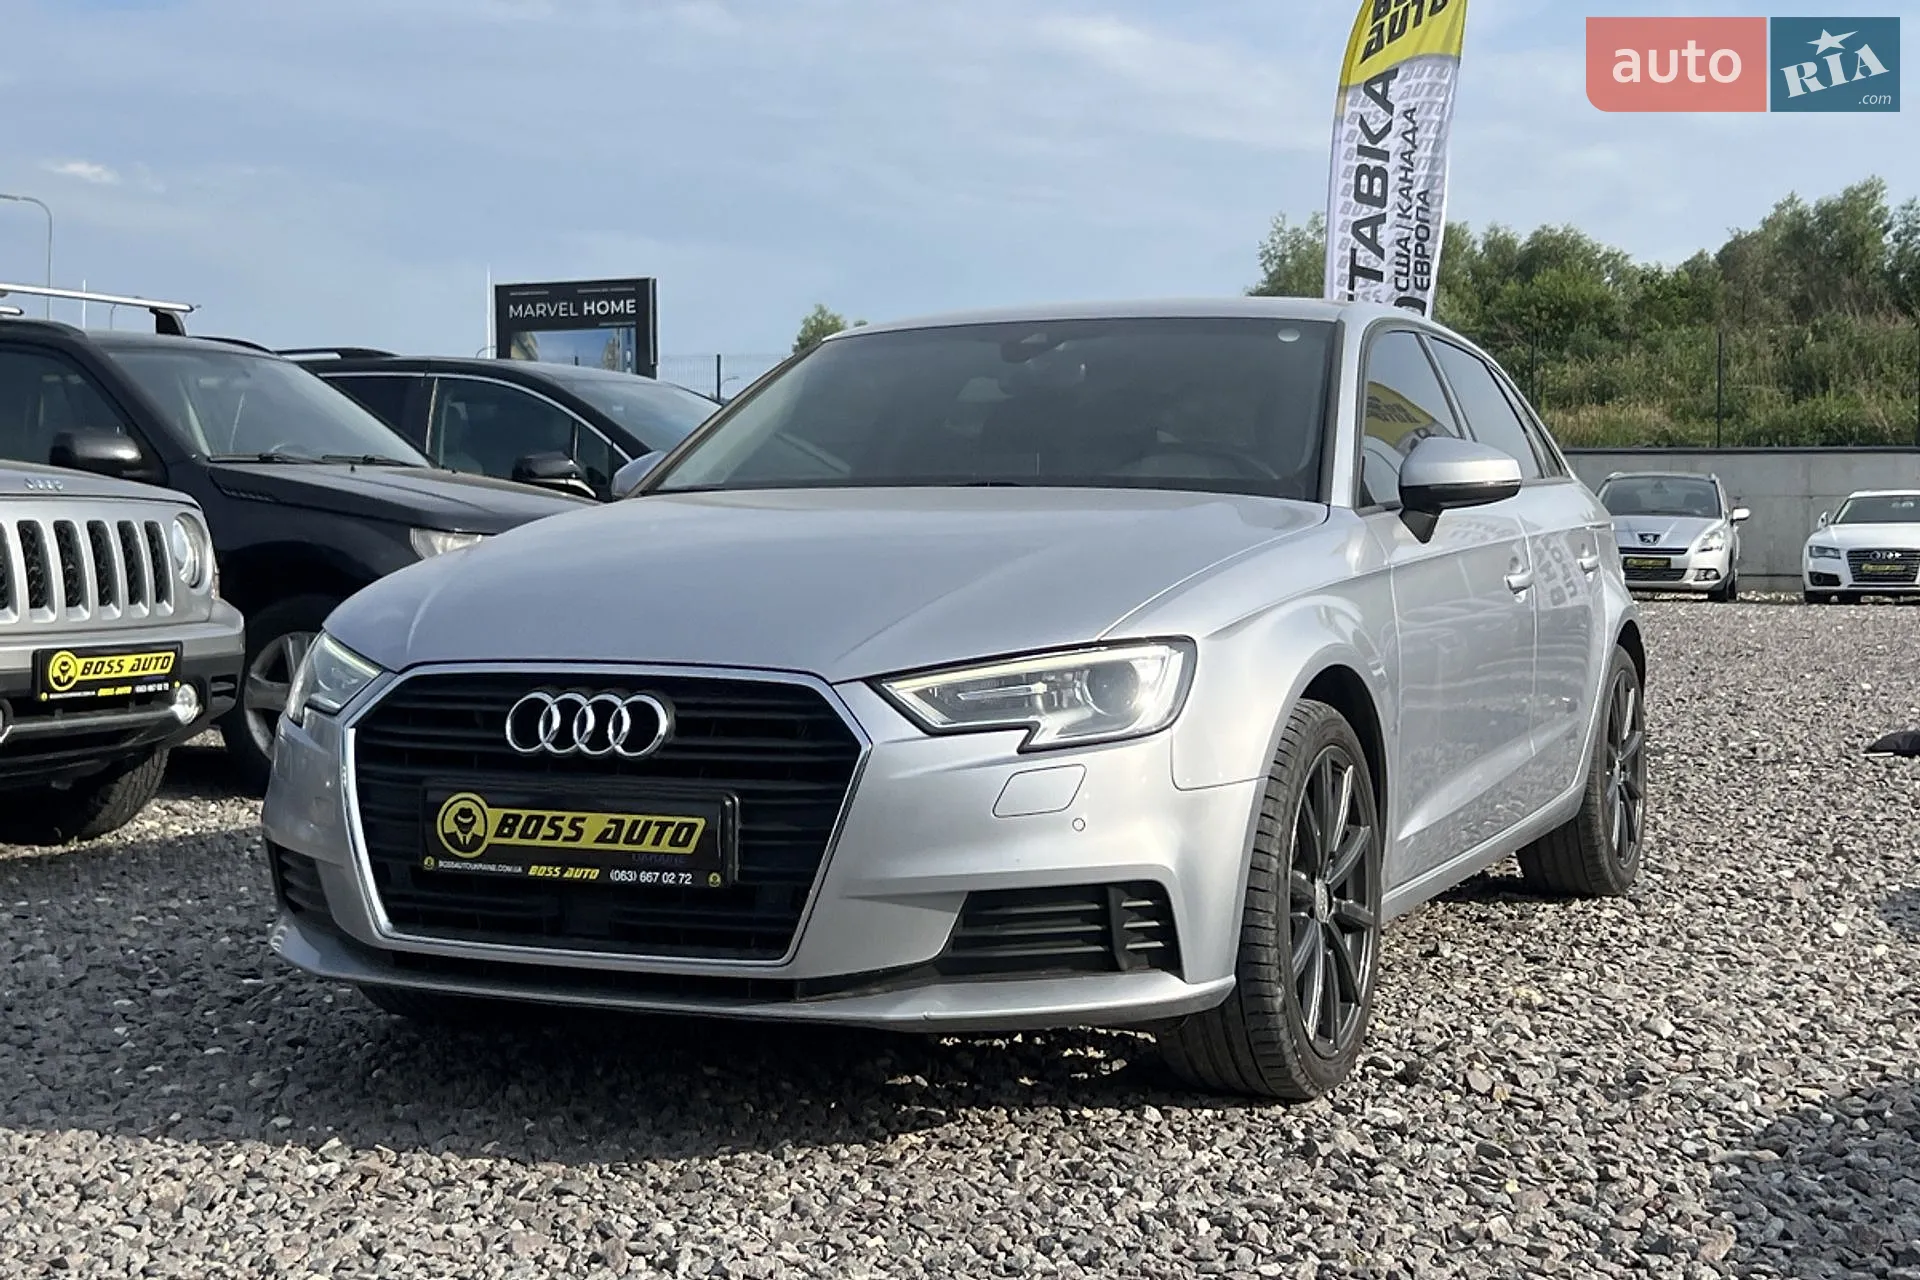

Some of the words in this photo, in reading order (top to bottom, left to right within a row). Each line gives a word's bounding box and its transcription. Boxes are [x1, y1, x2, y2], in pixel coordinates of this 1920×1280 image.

[1397, 107, 1419, 220] КАНАДА
[1348, 67, 1400, 302] ТАВКА
[1394, 236, 1411, 292] США
[509, 302, 579, 319] MARVEL
[583, 299, 637, 315] HOME
[81, 659, 125, 676] BOSS
[129, 655, 172, 673] AUTO
[493, 813, 588, 843] BOSS
[594, 818, 700, 848] AUTO
[528, 865, 561, 878] BOSS
[563, 867, 600, 880] AUTO
[609, 869, 638, 882] (063)
[639, 871, 660, 883] 667
[662, 872, 677, 884] 02
[678, 873, 693, 885] 72
